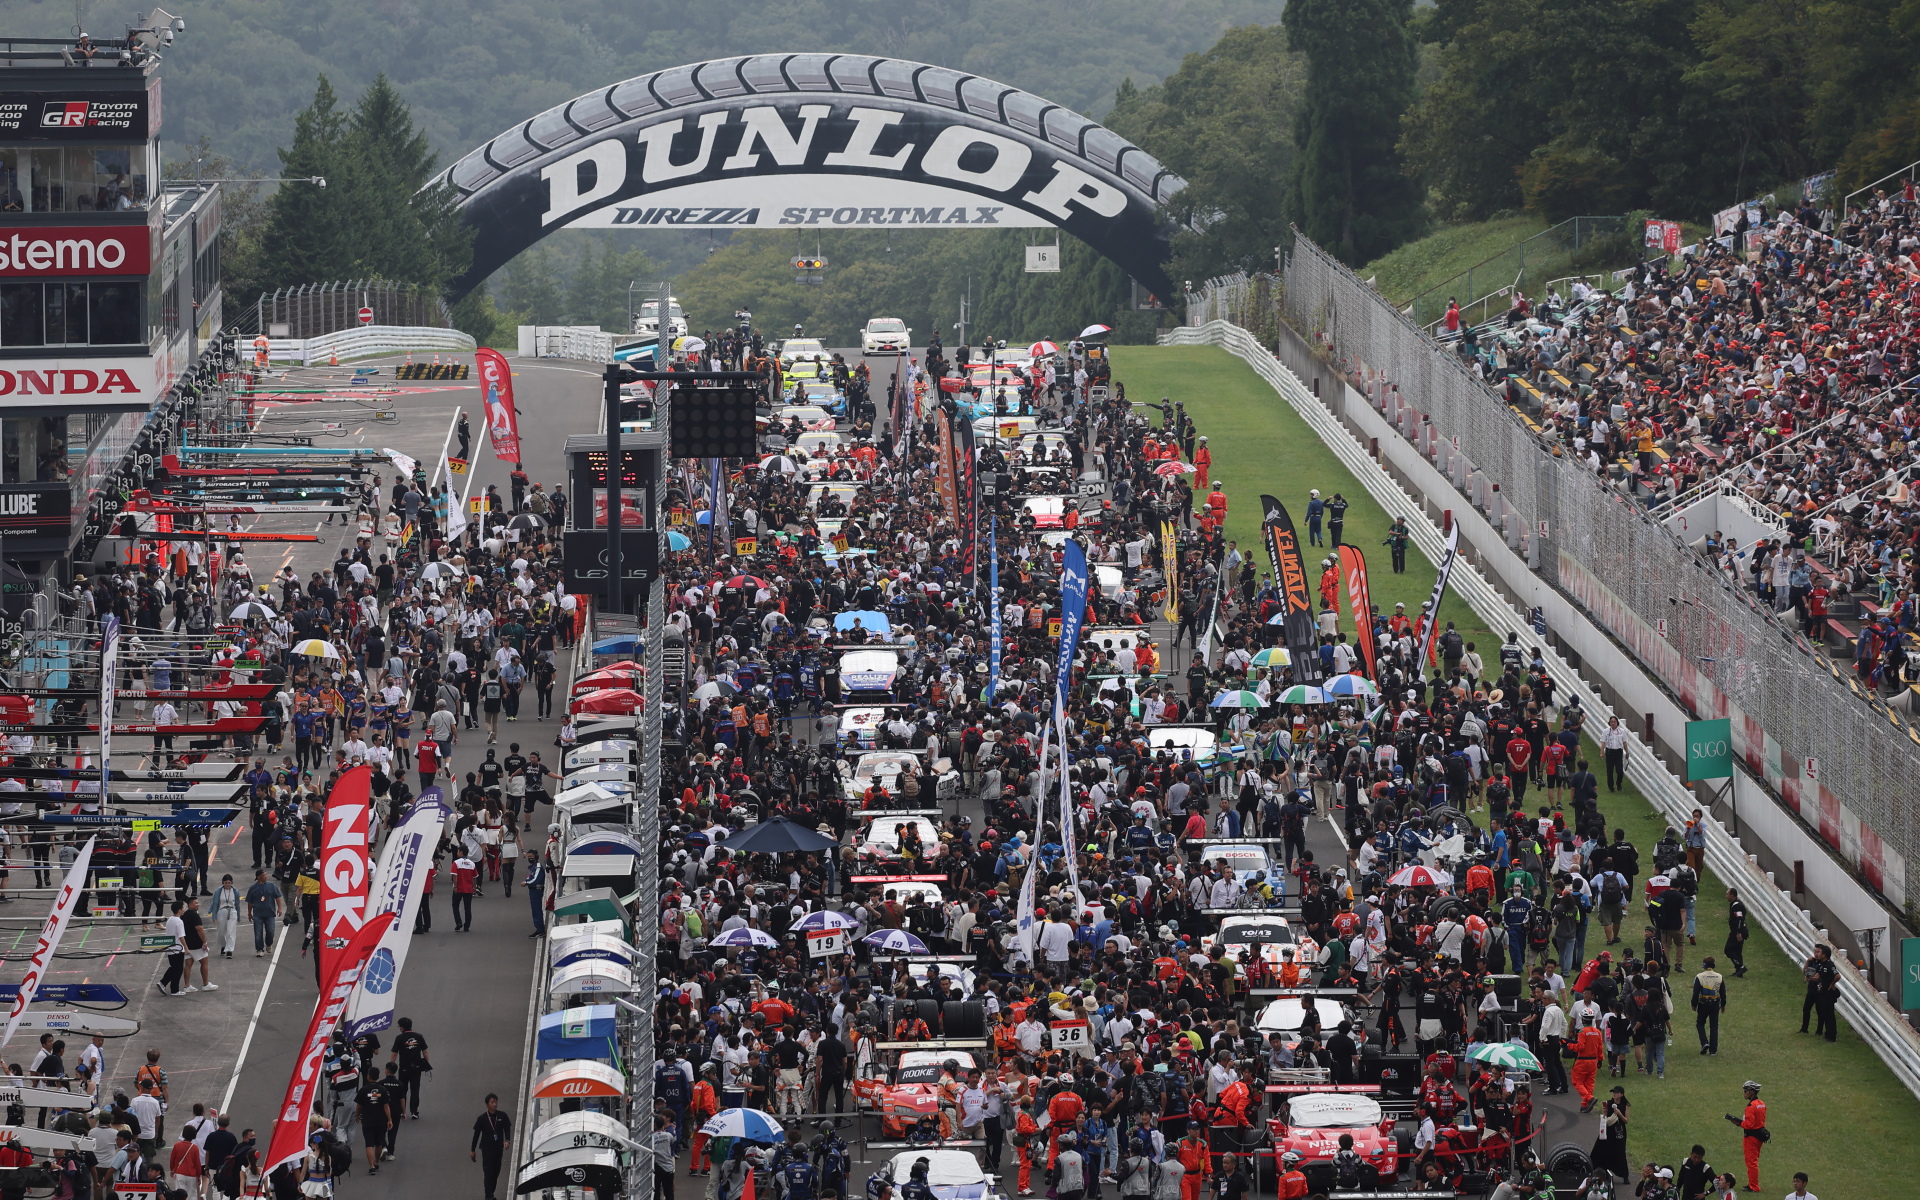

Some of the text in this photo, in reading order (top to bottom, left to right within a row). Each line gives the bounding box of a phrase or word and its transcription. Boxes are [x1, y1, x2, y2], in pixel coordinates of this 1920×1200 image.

[91, 102, 138, 110] TOYOTA
[43, 111, 84, 125] GR
[87, 119, 130, 128] Racing
[540, 103, 1128, 228] DUNLOP
[611, 206, 1004, 225] DIREZZA SPORTMAX
[0, 233, 126, 270] stemo
[1037, 252, 1047, 262] 16
[222, 343, 233, 351] 45
[182, 397, 194, 405] 39
[450, 463, 463, 472] 27
[122, 478, 134, 487] 31
[0, 493, 37, 515] LUBE
[104, 501, 118, 510] 29
[85, 526, 99, 535] 27
[740, 542, 753, 551] 48
[6, 622, 22, 633] 26
[1053, 624, 1060, 633] 9
[851, 674, 888, 682] REALIZE
[118, 690, 148, 698] MOTUL
[1692, 740, 1727, 759] SUGO
[324, 803, 366, 938] NGK
[384, 832, 412, 913] EALIZE
[897, 889, 938, 897] RTA
[830, 920, 842, 928] 19
[1340, 919, 1351, 927] 36
[813, 929, 839, 937] AUTOBACS
[143, 938, 154, 946] 52
[757, 936, 767, 944] 19
[816, 937, 834, 951] 19
[891, 940, 903, 948] 19
[1058, 1028, 1081, 1041] 36
[1518, 1056, 1534, 1066] NTK
[902, 1068, 936, 1079] ROOKIE
[562, 1082, 593, 1095] au
[666, 1088, 680, 1097] 043
[573, 1135, 587, 1147] 96
[1308, 1140, 1365, 1149] Nitea
